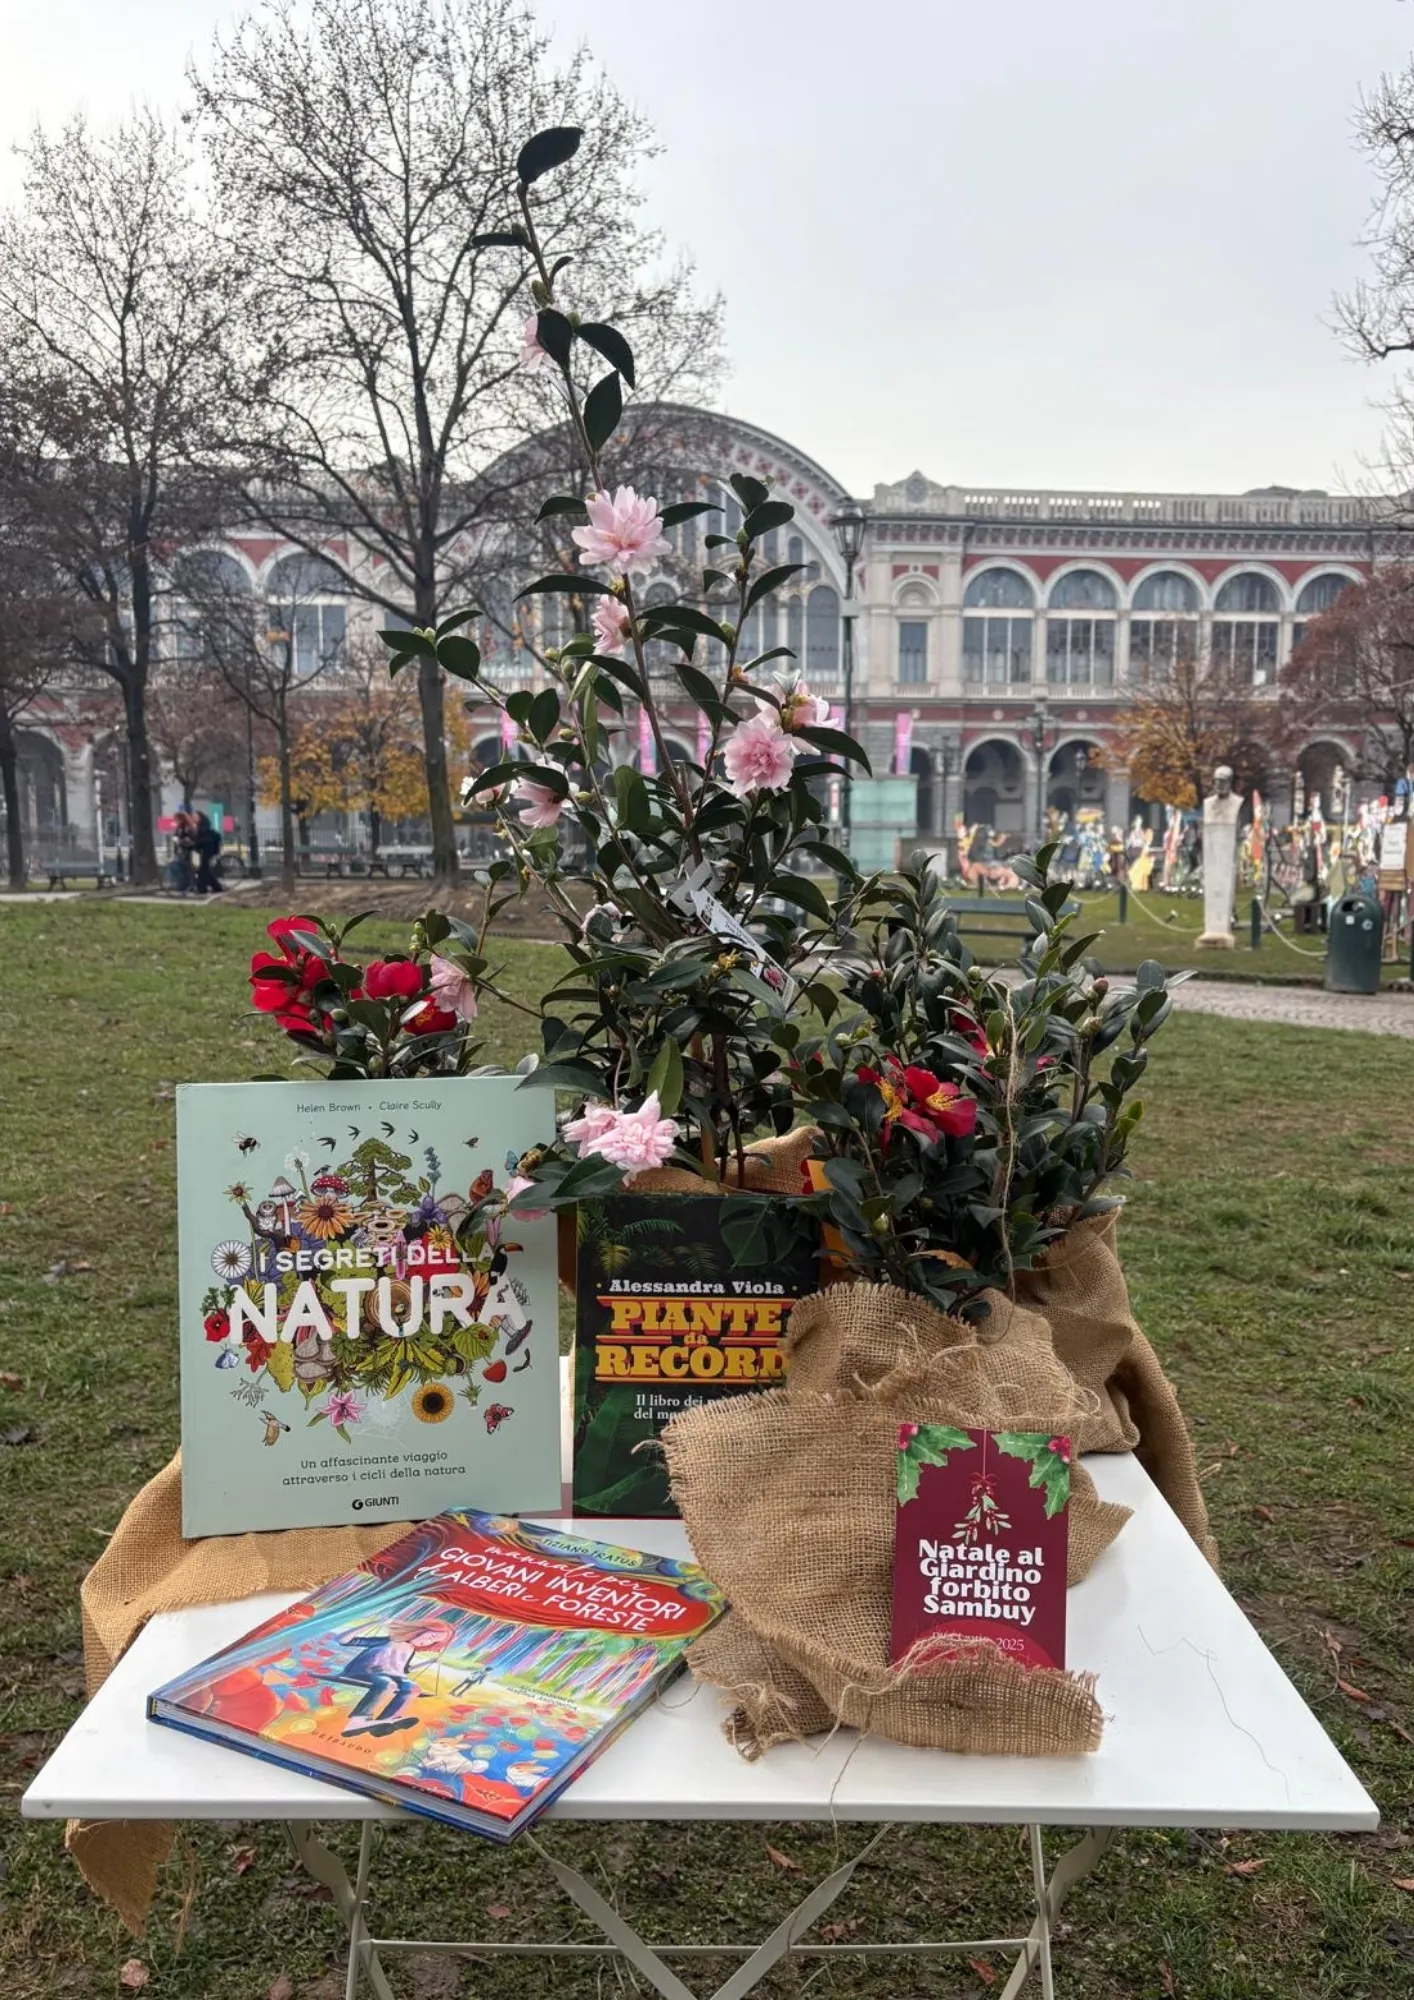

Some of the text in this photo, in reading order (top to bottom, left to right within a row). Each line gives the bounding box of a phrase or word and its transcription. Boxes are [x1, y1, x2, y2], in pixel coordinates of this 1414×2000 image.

[296, 1100, 442, 1113] Helen Brown Claire Scully
[259, 1242, 495, 1273] I SEGRETI DELLA
[609, 1279, 785, 1295] Alessandra Viola
[228, 1271, 528, 1345] NATURA
[610, 1300, 783, 1335] PIANTE
[684, 1332, 709, 1345] da
[634, 1407, 653, 1420] del
[635, 1394, 646, 1407] Il
[649, 1394, 681, 1407] libro
[684, 1395, 703, 1407] dei
[300, 1450, 448, 1470] Un affascinante viaggio
[282, 1472, 348, 1486] attraverso
[360, 1469, 387, 1481] cicli
[390, 1467, 420, 1479] della
[424, 1465, 466, 1477] natura
[364, 1496, 399, 1508] GIUNTI
[484, 1545, 600, 1579] manuale
[918, 1538, 1045, 1566] Natale al
[440, 1547, 688, 1620] GIOVANI INVENTORI
[919, 1557, 1042, 1585] Giardino
[442, 1570, 528, 1597] ALBERI
[542, 1594, 655, 1632] FORESTE
[930, 1576, 1031, 1602] forbito
[923, 1594, 1036, 1626] Sambuy
[996, 1637, 1025, 1652] 2025
